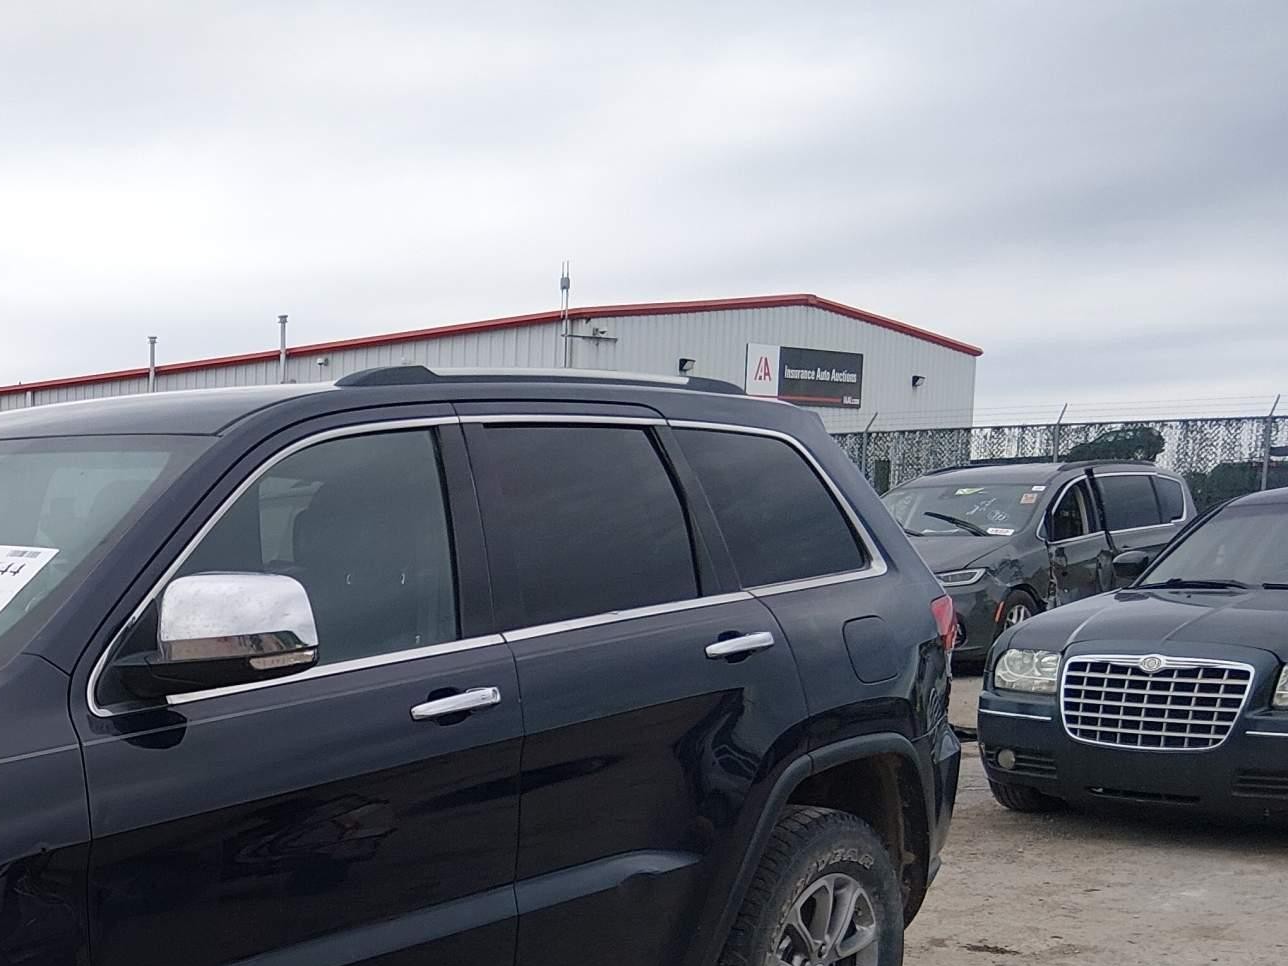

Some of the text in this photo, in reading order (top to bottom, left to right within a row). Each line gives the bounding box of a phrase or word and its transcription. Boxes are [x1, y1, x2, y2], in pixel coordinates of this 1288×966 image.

[785, 365, 857, 383] Insurance Auto Auctions
